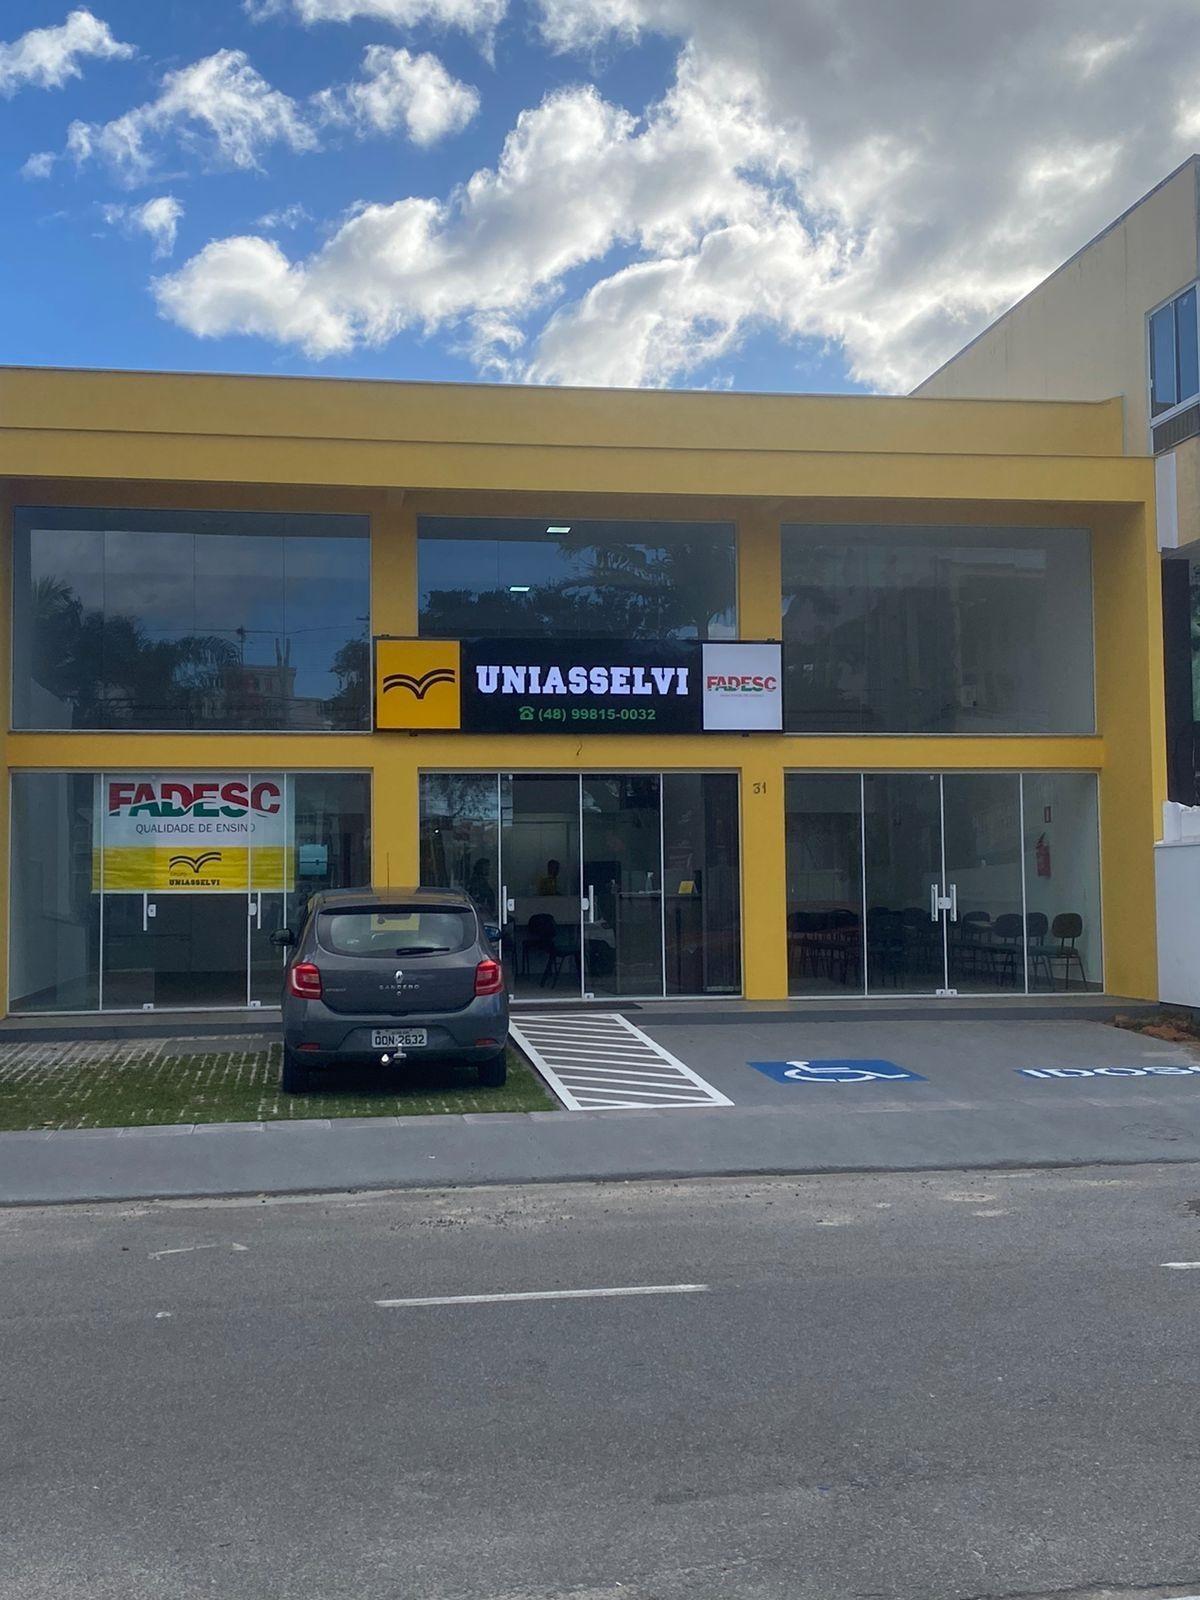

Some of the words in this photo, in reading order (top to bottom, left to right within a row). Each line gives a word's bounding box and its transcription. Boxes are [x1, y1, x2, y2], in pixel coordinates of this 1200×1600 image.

[476, 665, 689, 695] UNIASSELVI
[706, 676, 777, 692] FADESC
[538, 708, 567, 722] (48)
[571, 708, 656, 720] 99815-0032
[752, 781, 767, 794] 31
[108, 782, 281, 818] FADESC
[136, 823, 195, 834] QUALIDADE
[198, 823, 212, 833] DE
[1023, 1066, 1200, 1077] IDOS
